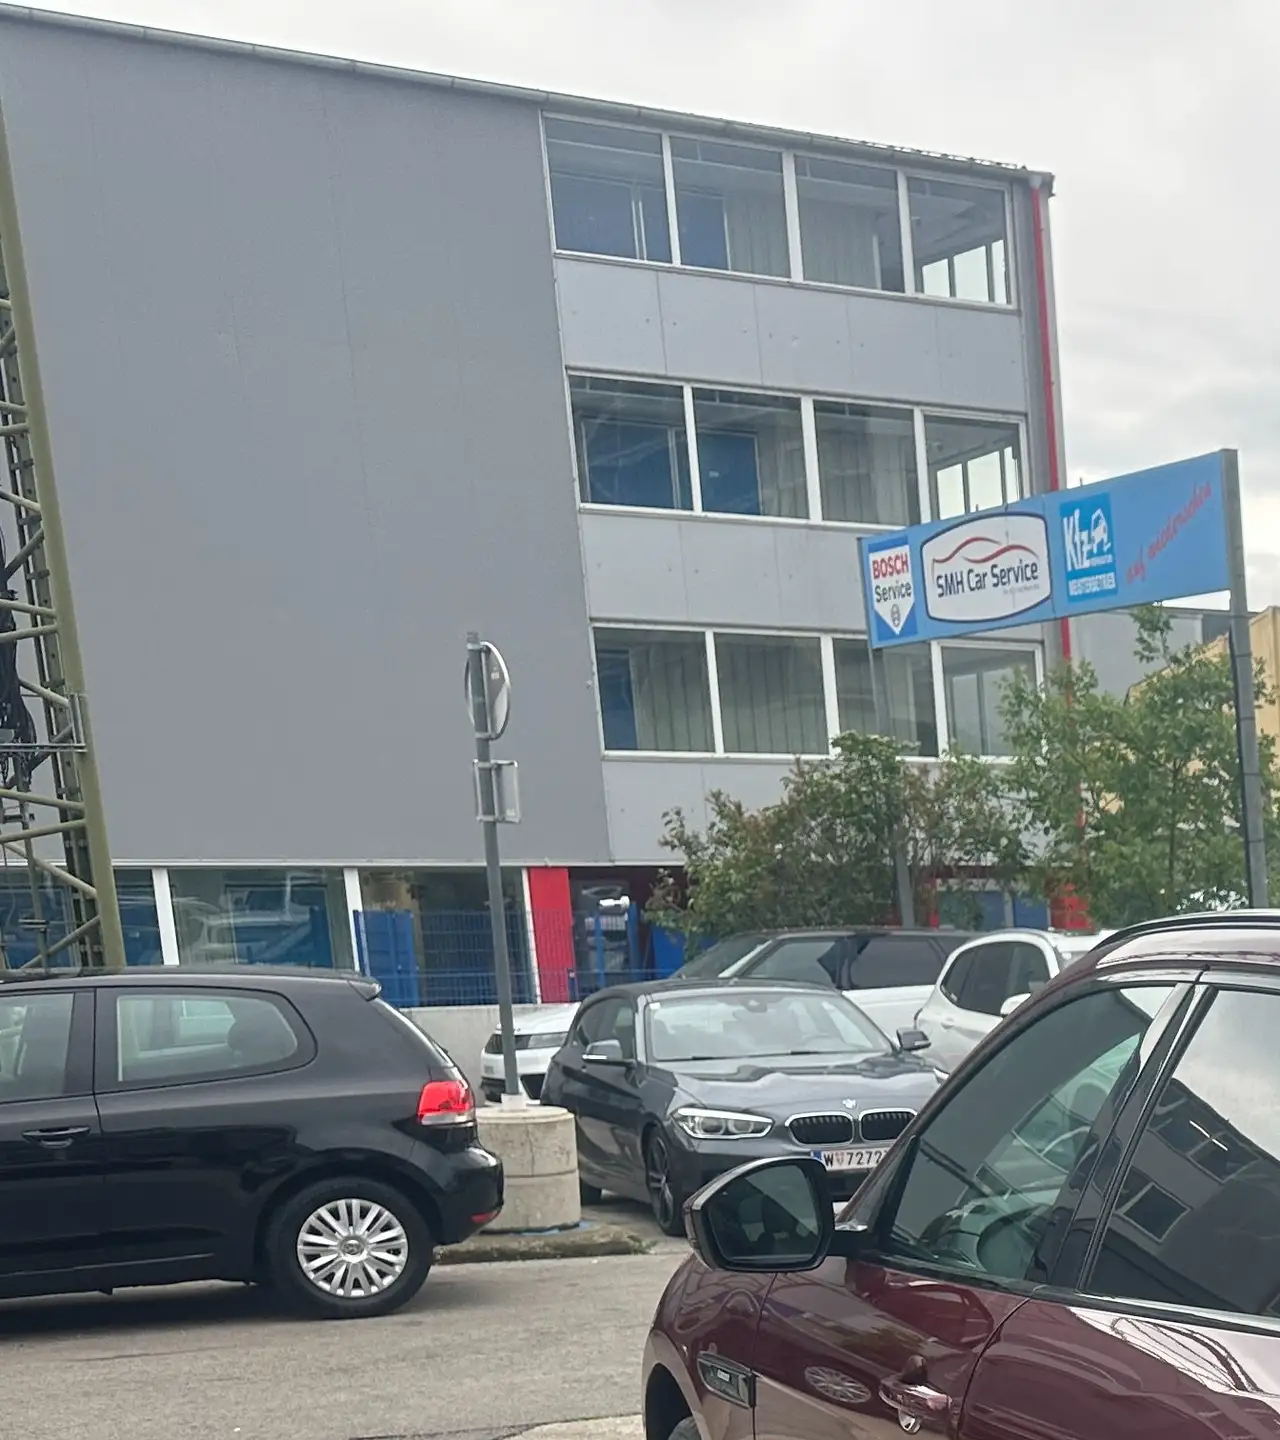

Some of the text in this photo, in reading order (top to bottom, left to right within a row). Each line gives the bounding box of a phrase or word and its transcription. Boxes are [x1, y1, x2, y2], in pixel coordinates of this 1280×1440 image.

[872, 553, 909, 580] BOSCH
[936, 571, 965, 598] SMH
[967, 568, 988, 592] Car
[990, 558, 1039, 588] Service
[874, 580, 912, 603] Service
[823, 1150, 888, 1167] W 7272
